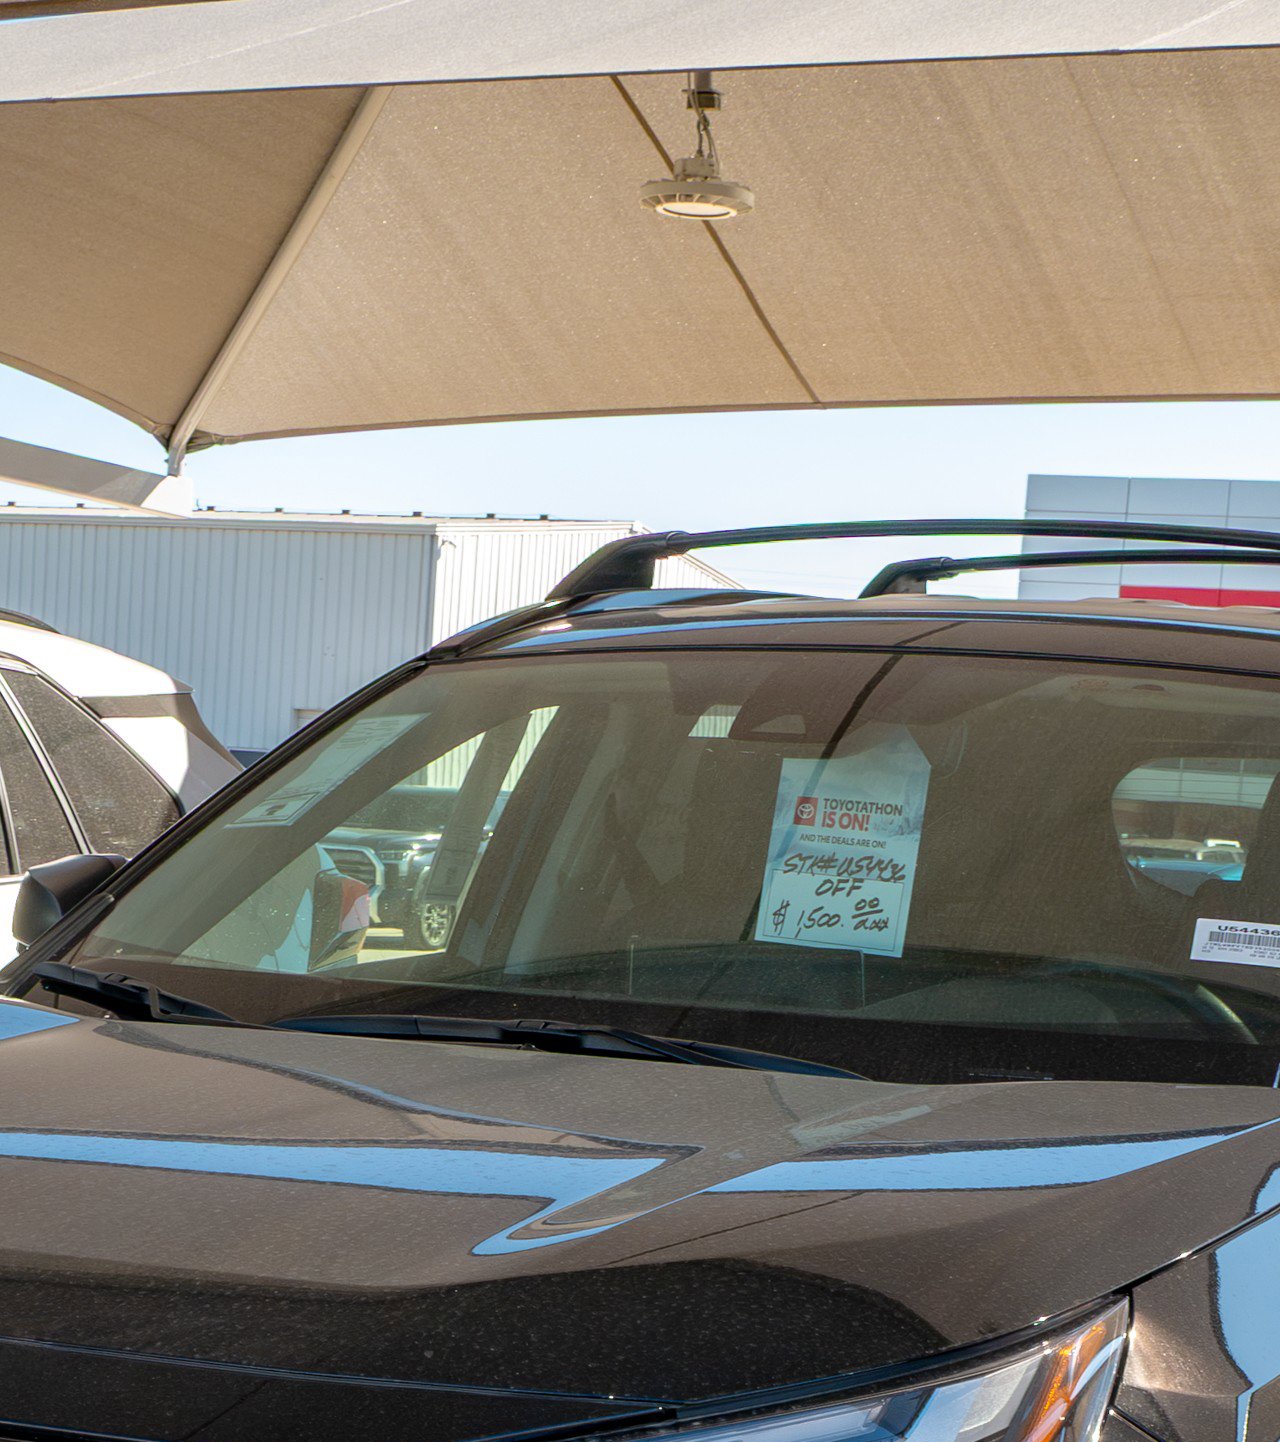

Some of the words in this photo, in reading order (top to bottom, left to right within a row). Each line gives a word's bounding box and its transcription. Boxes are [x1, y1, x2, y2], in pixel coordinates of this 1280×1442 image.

[822, 798, 904, 816] TOYOTATHON
[838, 813, 871, 832] ON!
[800, 833, 816, 842] AND
[816, 835, 830, 844] THE
[831, 836, 856, 846] DEALS
[856, 839, 871, 848] ARE
[871, 840, 887, 849] ON!
[815, 878, 865, 897] OFF
